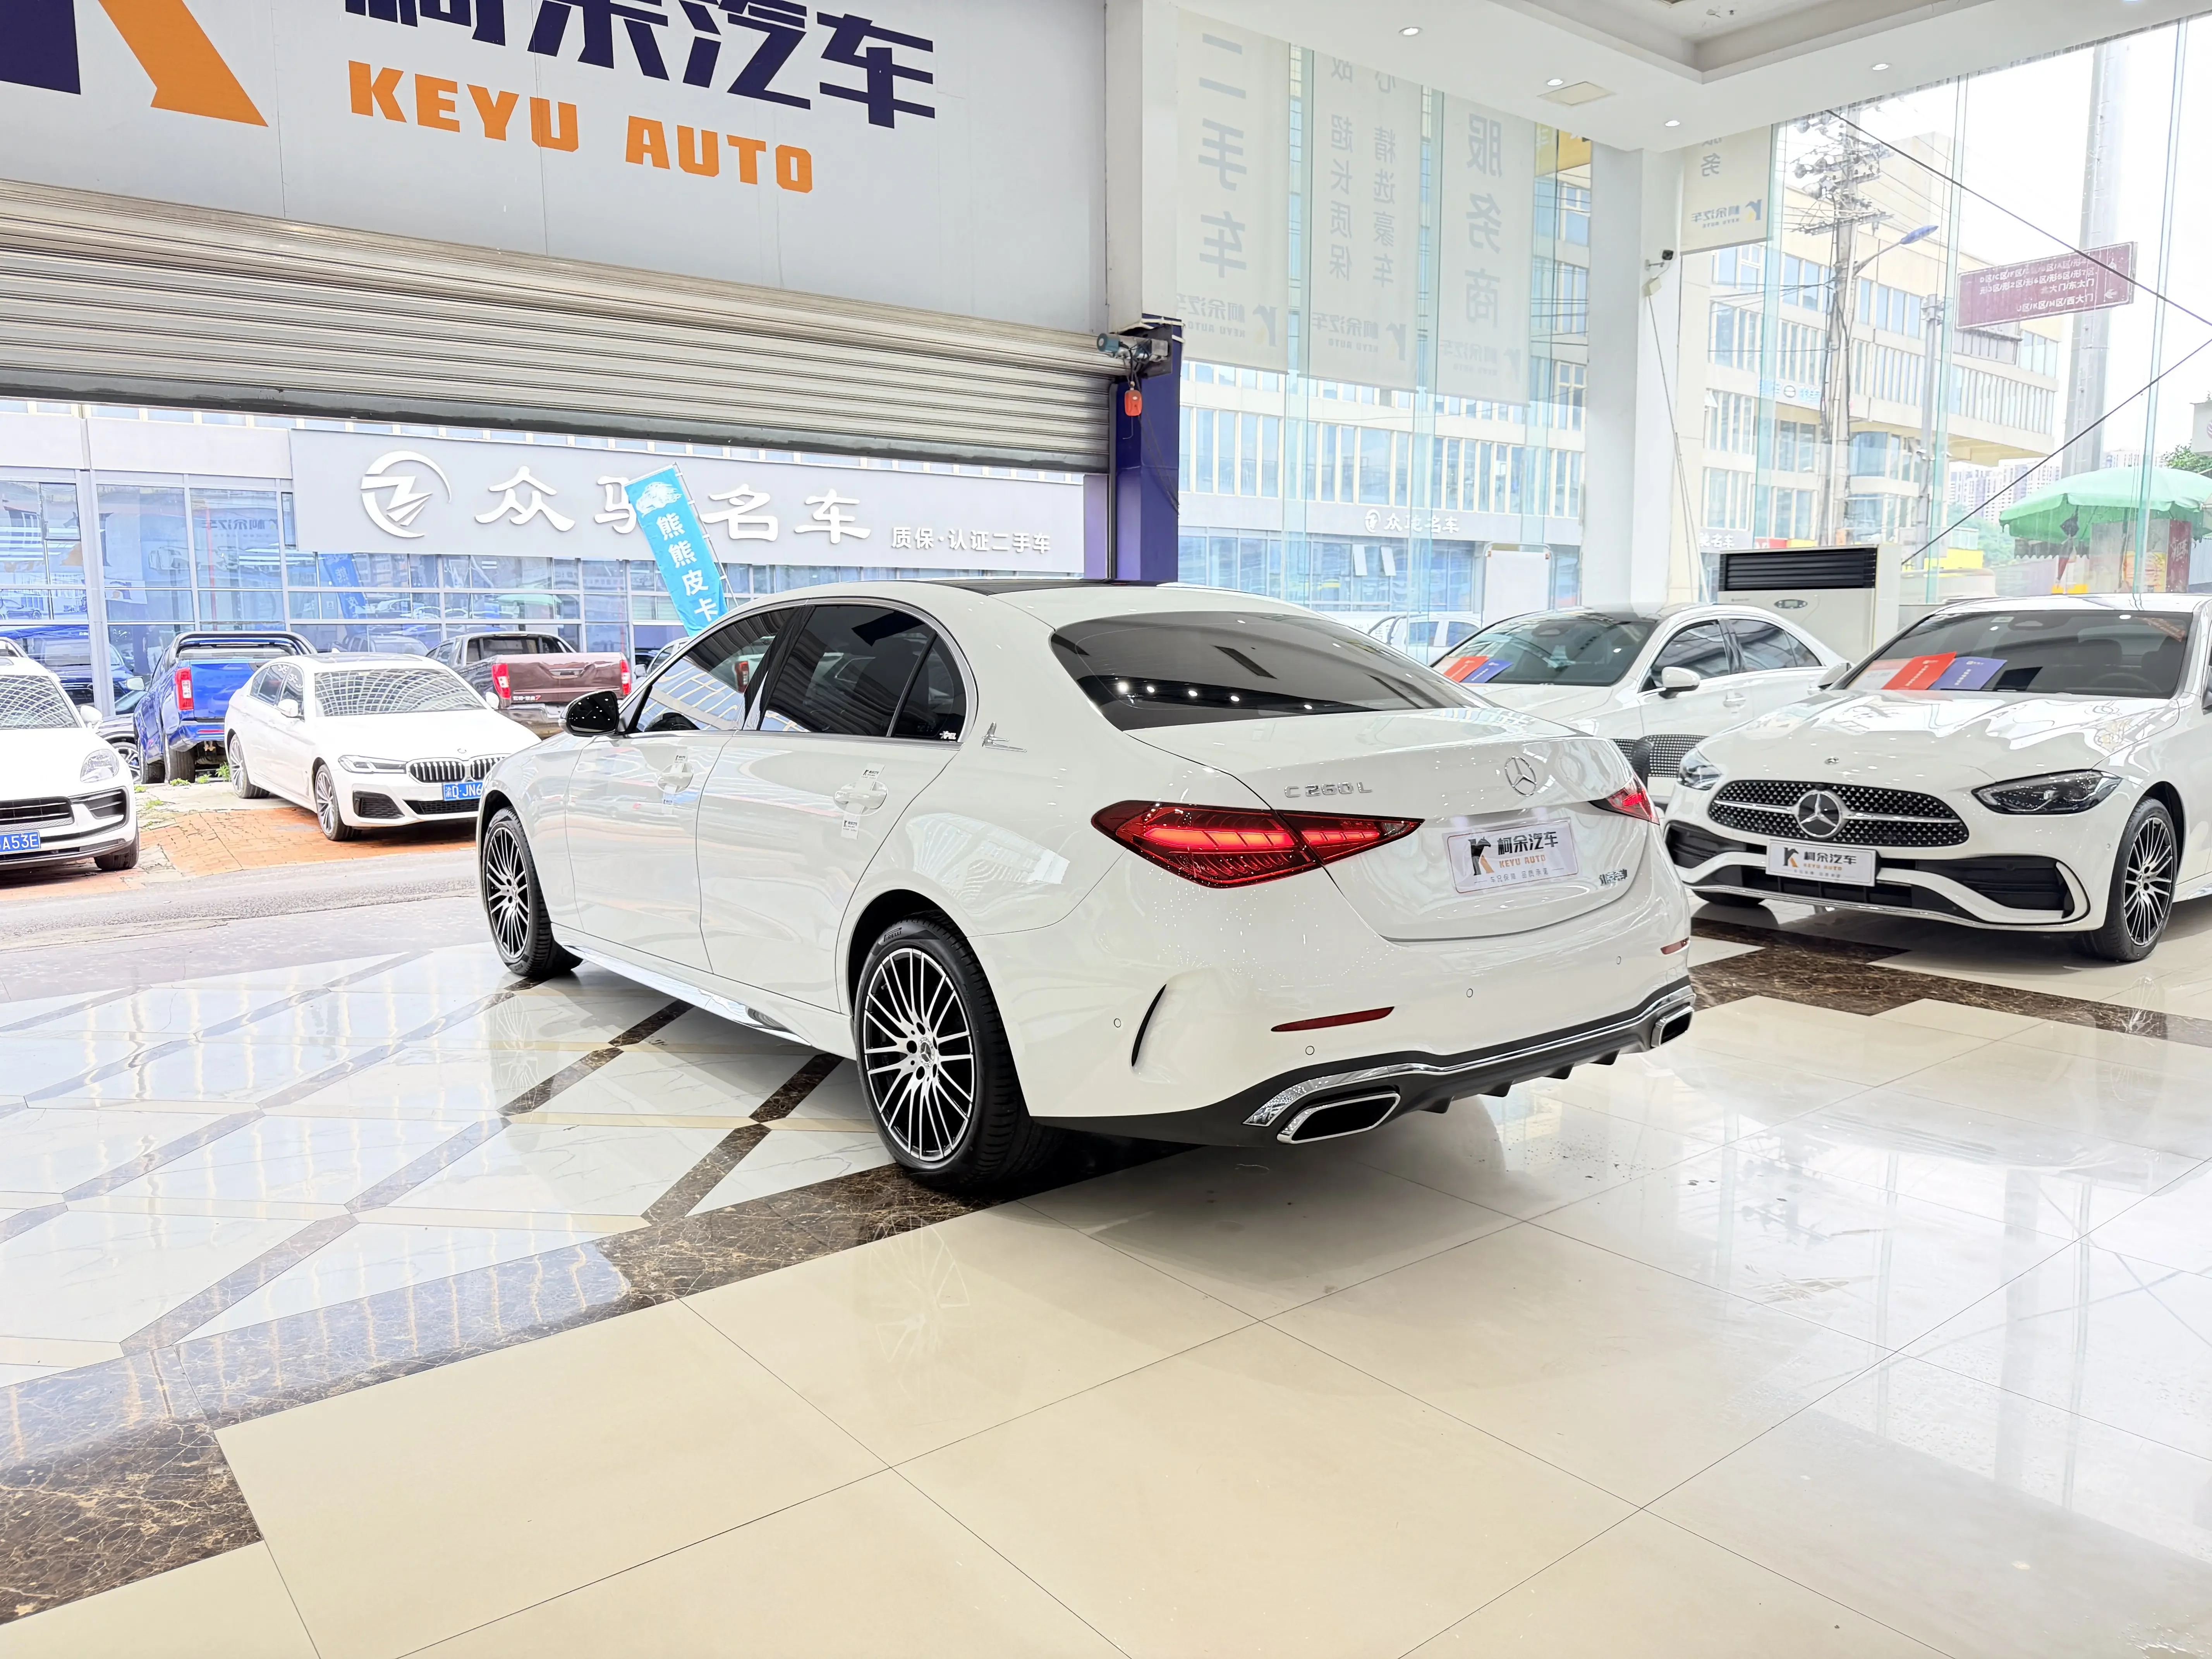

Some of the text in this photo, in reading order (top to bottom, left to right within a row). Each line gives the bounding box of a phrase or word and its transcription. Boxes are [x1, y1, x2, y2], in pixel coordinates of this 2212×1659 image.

[348, 60, 812, 193] KEYU AUTO
[656, 512, 718, 622] 熊熊皮卡
[939, 731, 956, 739] XPEL
[3, 834, 39, 850] A53E
[1498, 831, 1558, 855] 柯余汽车
[1499, 855, 1546, 868] KEYU AUTO
[884, 927, 902, 942] PIRELLI
